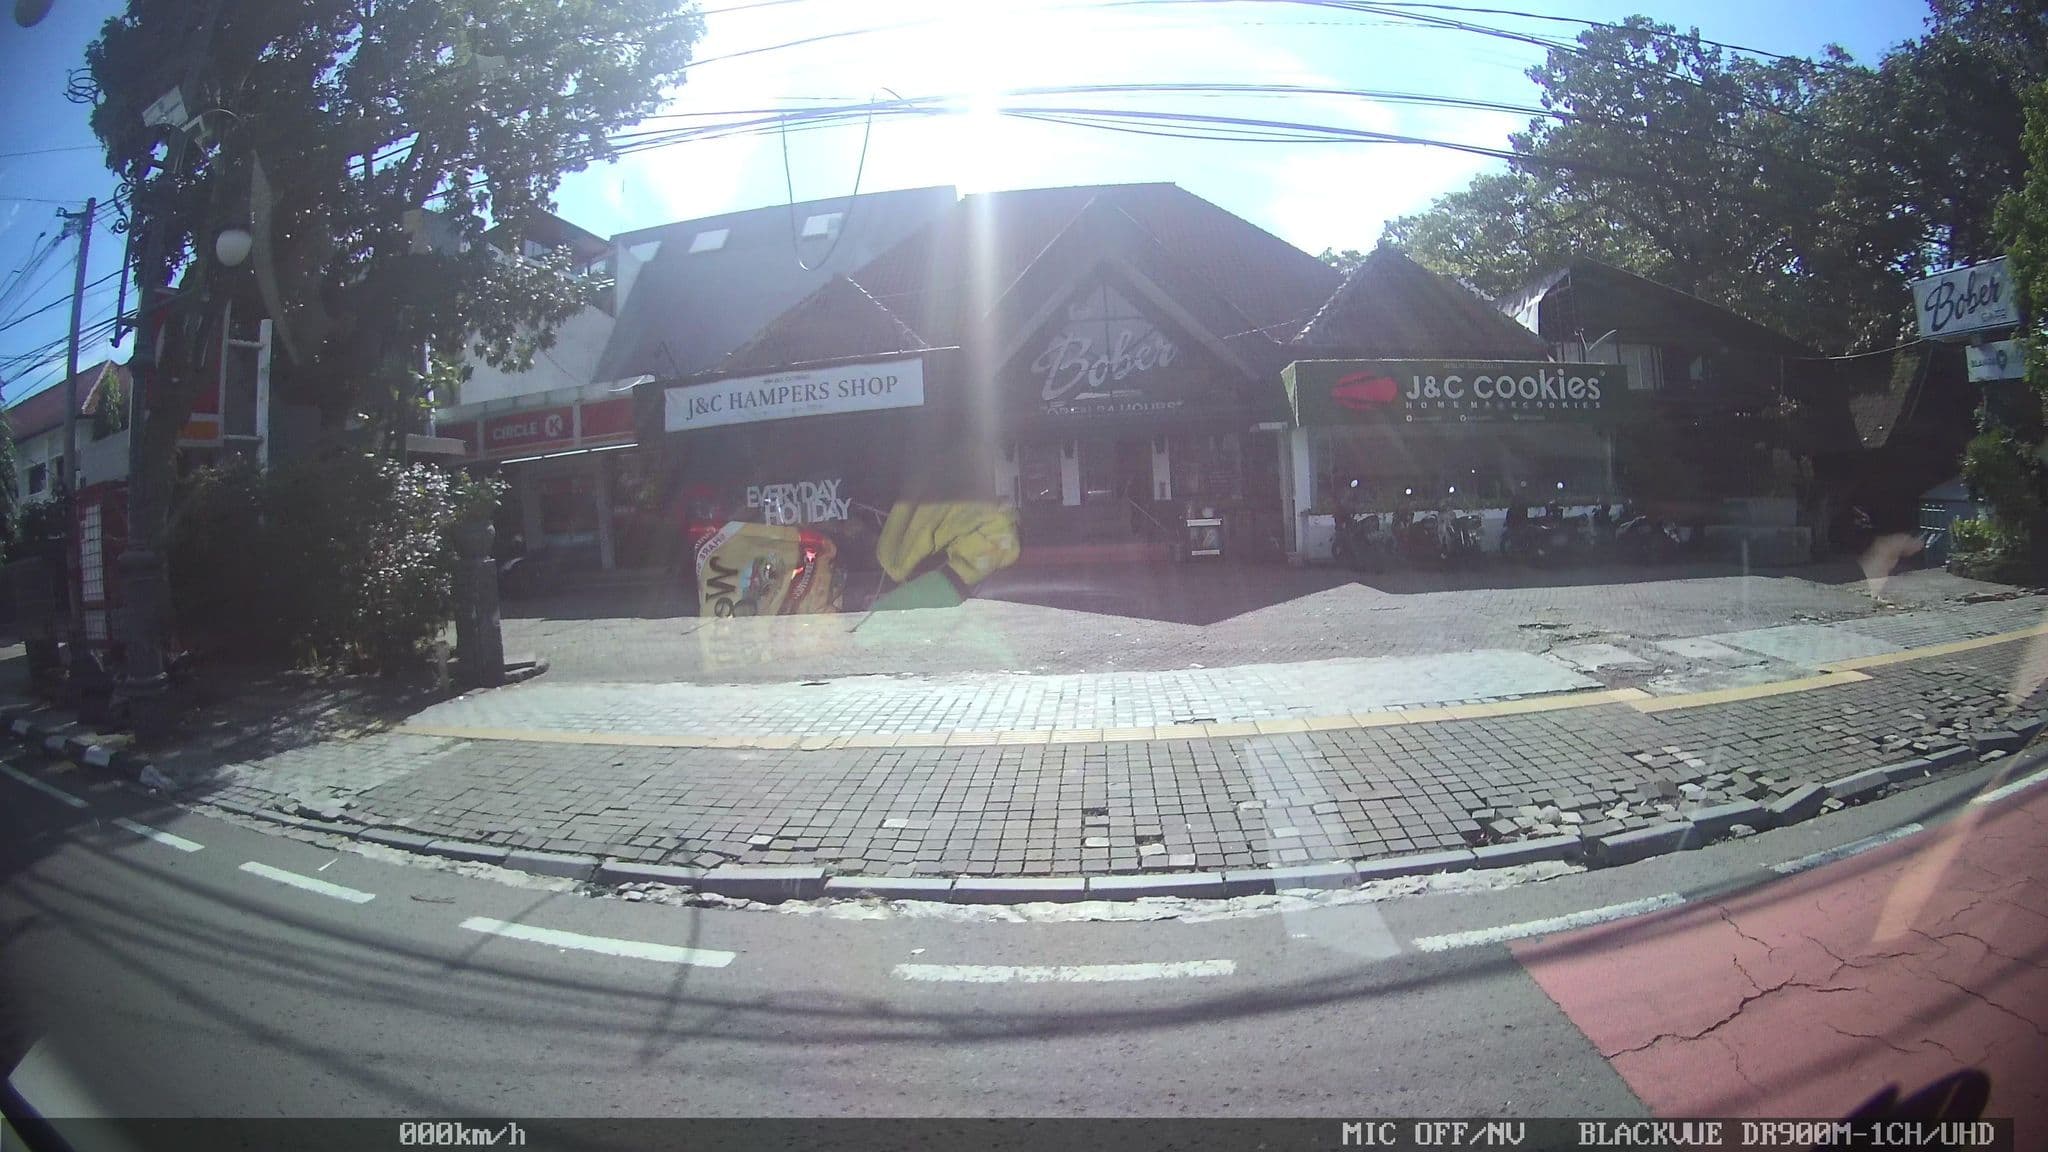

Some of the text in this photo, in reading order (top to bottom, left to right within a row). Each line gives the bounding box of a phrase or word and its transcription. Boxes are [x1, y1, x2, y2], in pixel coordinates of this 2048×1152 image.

[1925, 271, 1999, 331] Bober
[1031, 331, 1177, 400] Bober
[1406, 368, 1601, 400] J&C cookies
[686, 394, 723, 420] J&C
[729, 382, 830, 411] HAMPERS
[837, 375, 899, 399] SHOP
[493, 414, 562, 440] CIRCLE K
[746, 479, 842, 509] EVERYDAY
